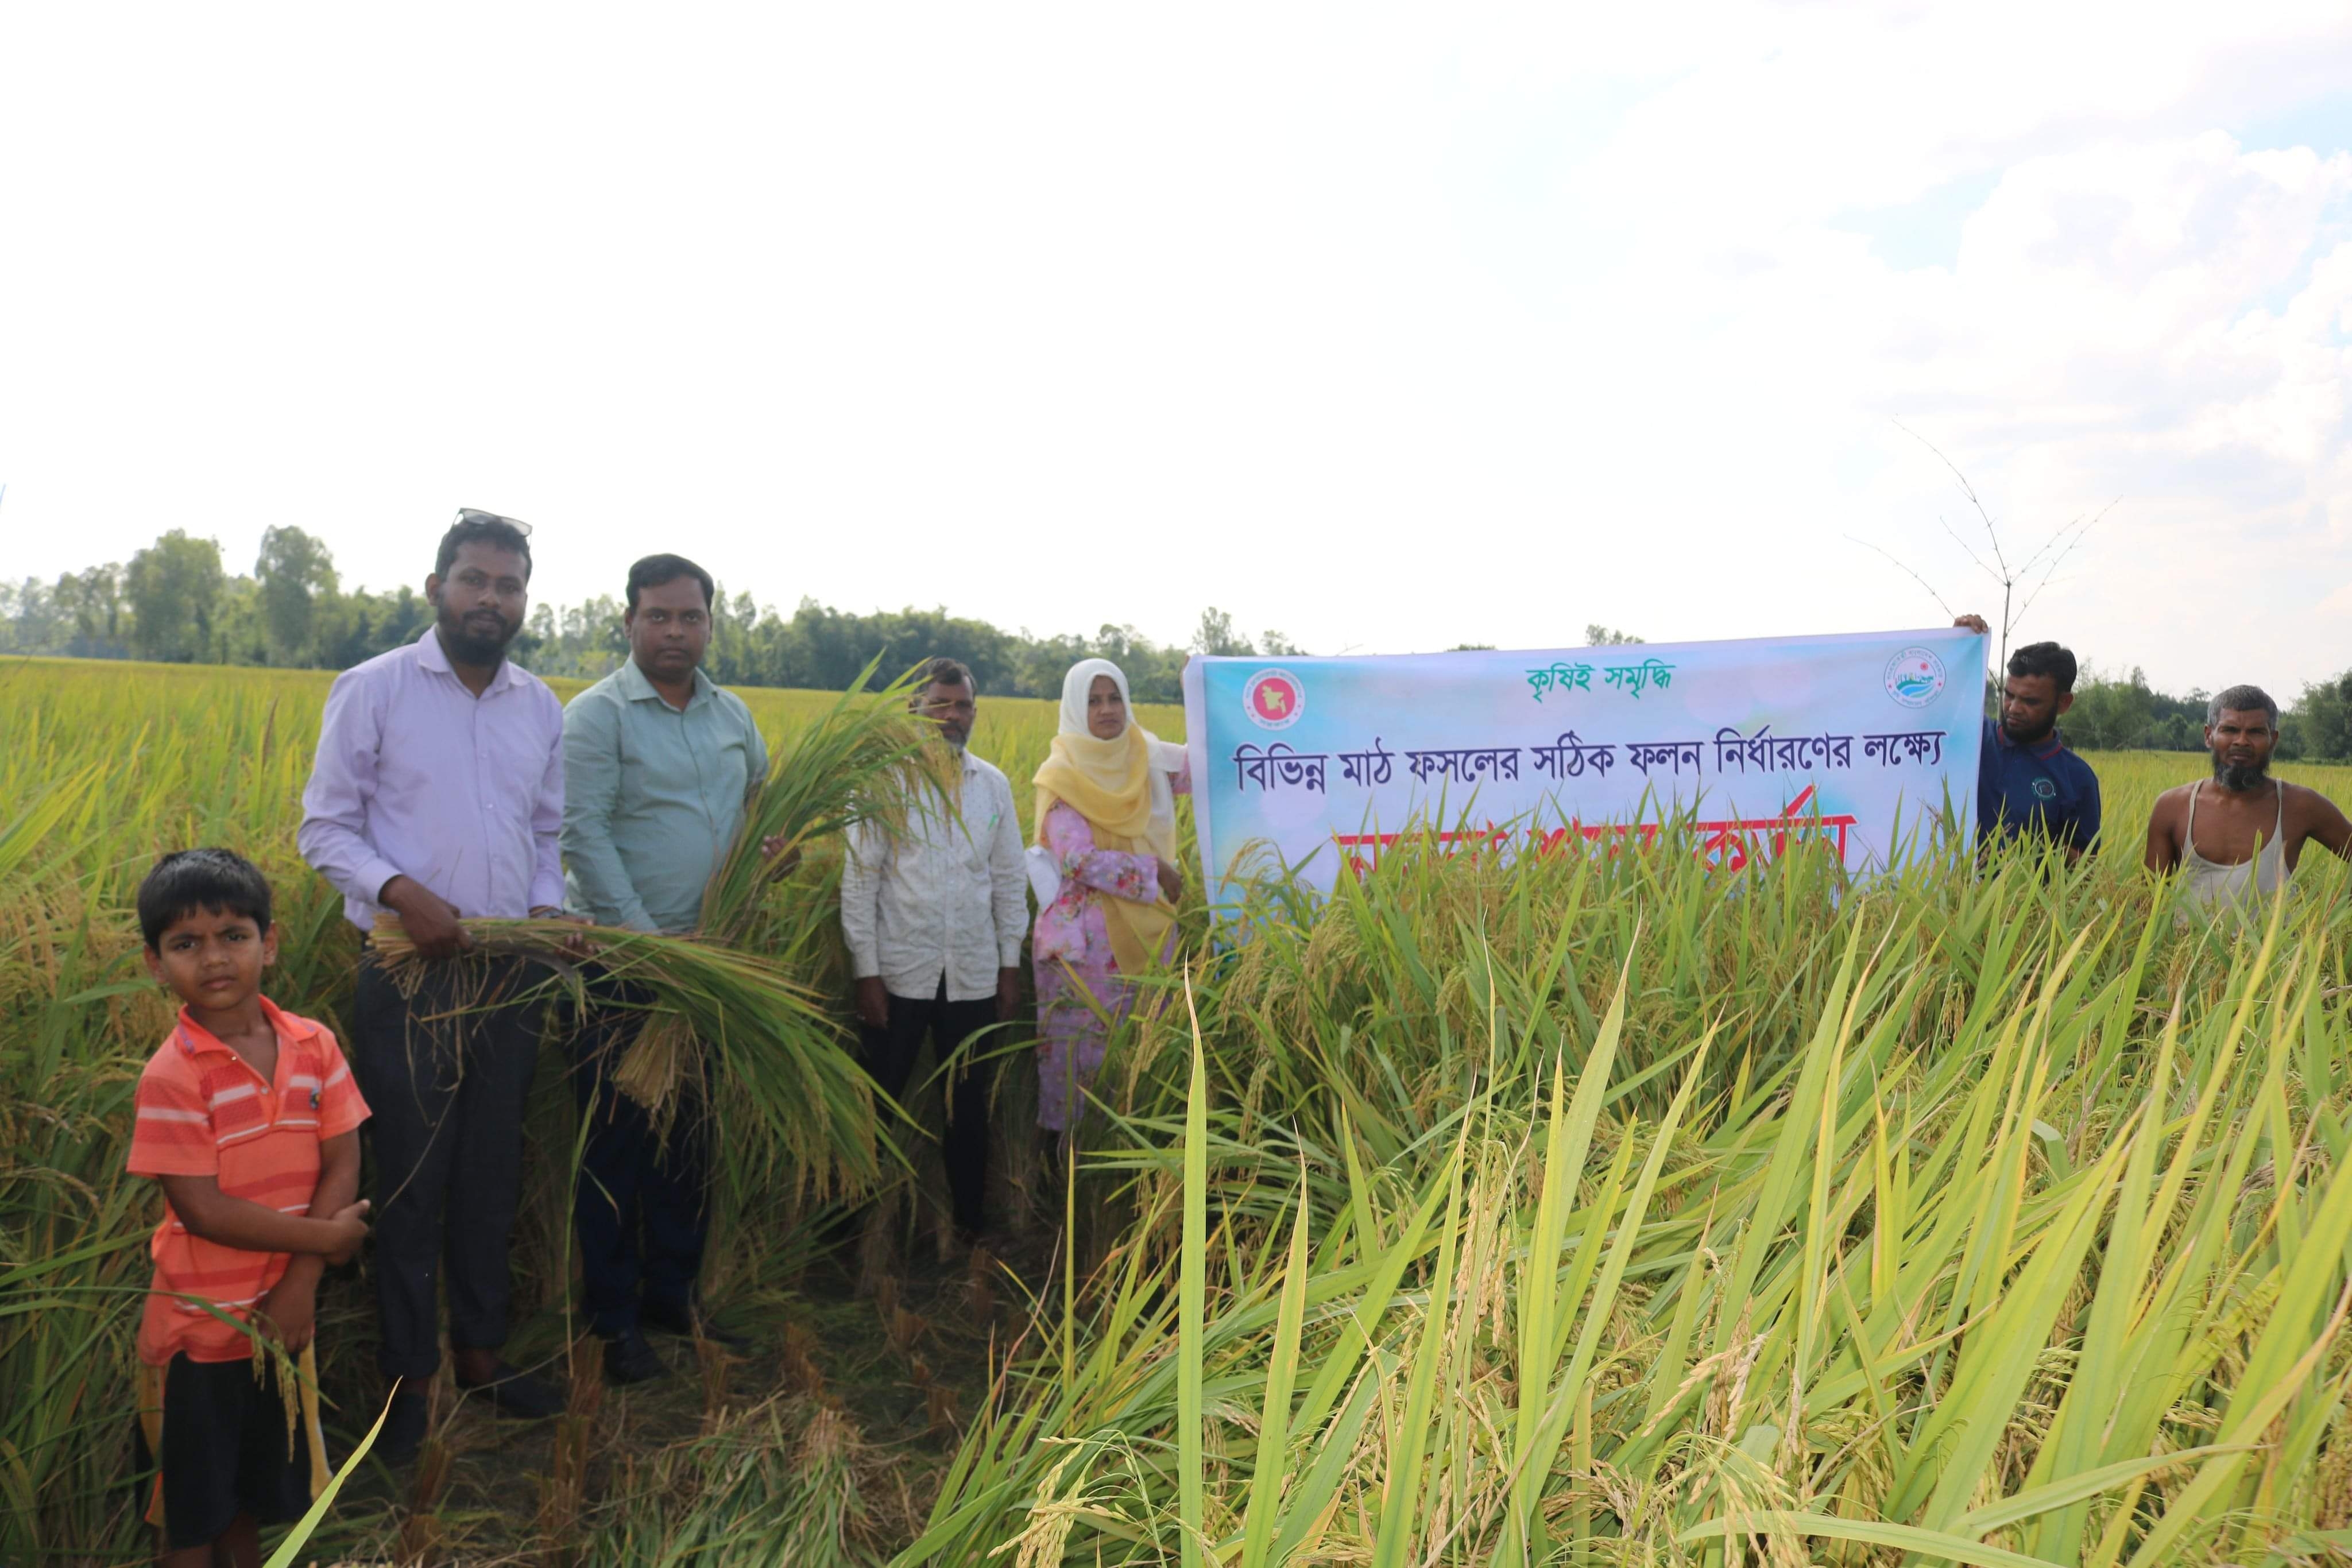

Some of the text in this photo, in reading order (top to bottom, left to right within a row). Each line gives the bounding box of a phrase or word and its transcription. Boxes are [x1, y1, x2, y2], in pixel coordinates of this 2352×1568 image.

[1526, 658, 1677, 703] কৃষিই সমৃদ্ধি
[1232, 725, 1947, 795] বিভিন্ন মাঠ ফসলের সঠিক ফলন নির্ধারণের লক্ষ্যে
